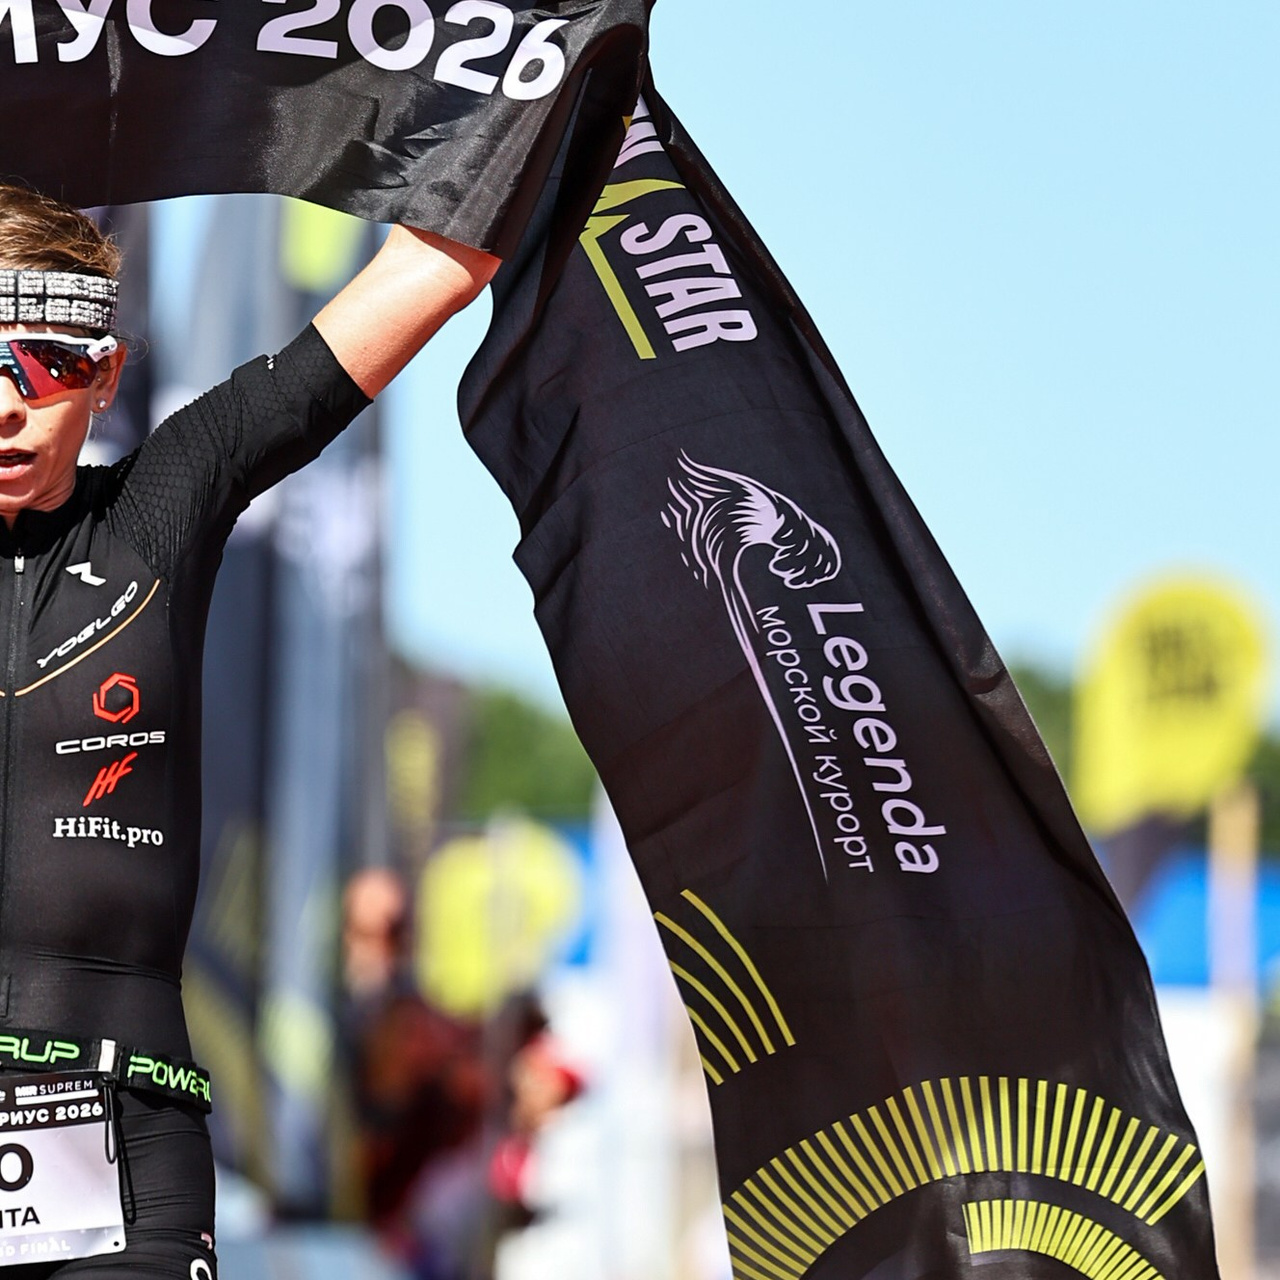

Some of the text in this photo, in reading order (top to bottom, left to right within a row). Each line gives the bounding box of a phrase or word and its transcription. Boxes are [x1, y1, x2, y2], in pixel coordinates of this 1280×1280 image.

[619, 212, 759, 353] STAR
[55, 730, 166, 755] COROS
[756, 605, 874, 874] морской курорт
[806, 602, 948, 874] Legenda
[52, 816, 165, 849] HiFit.pro
[39, 1080, 94, 1096] SUPREM
[55, 1101, 105, 1121] 2026
